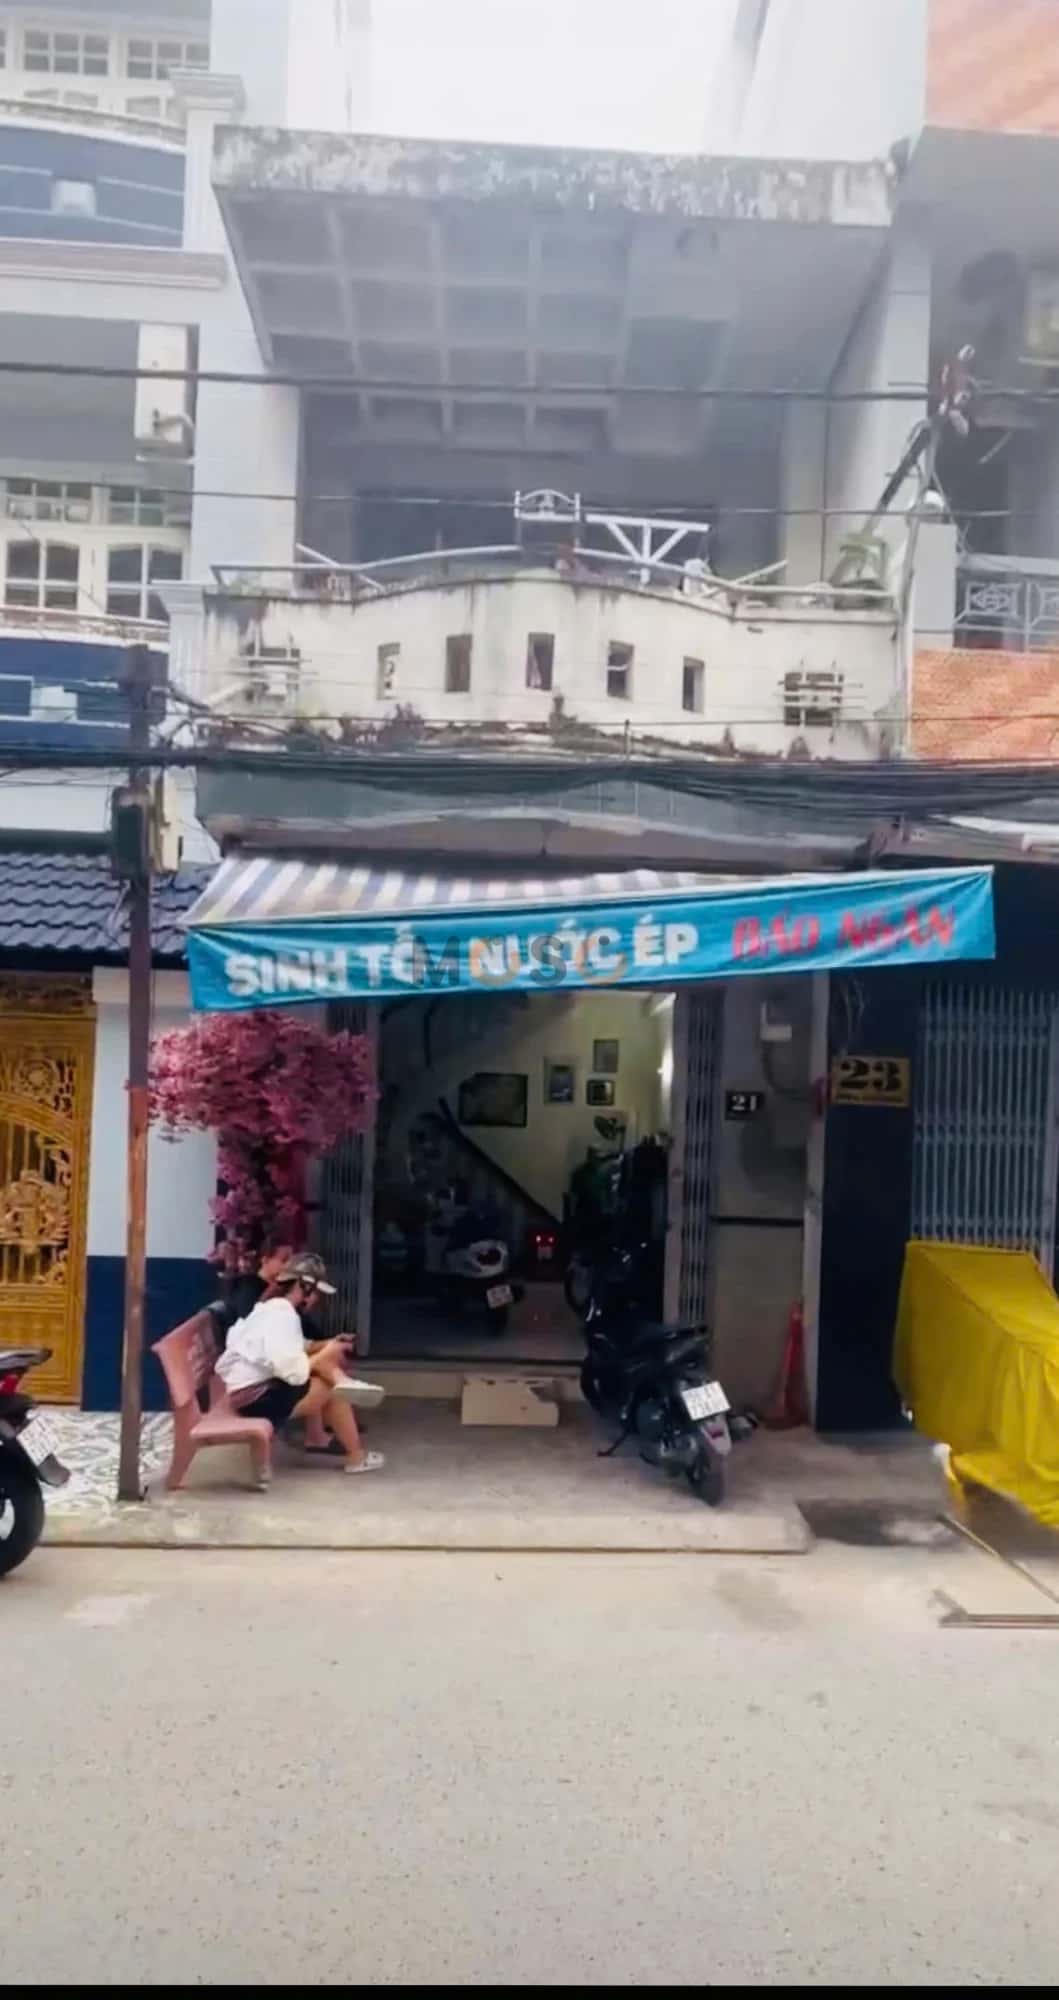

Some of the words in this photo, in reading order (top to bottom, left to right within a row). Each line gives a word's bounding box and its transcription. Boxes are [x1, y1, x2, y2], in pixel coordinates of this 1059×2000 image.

[225, 947, 347, 996] SINH
[634, 913, 698, 968] ÉP
[839, 1059, 902, 1092] 23
[731, 1094, 758, 1112] 21
